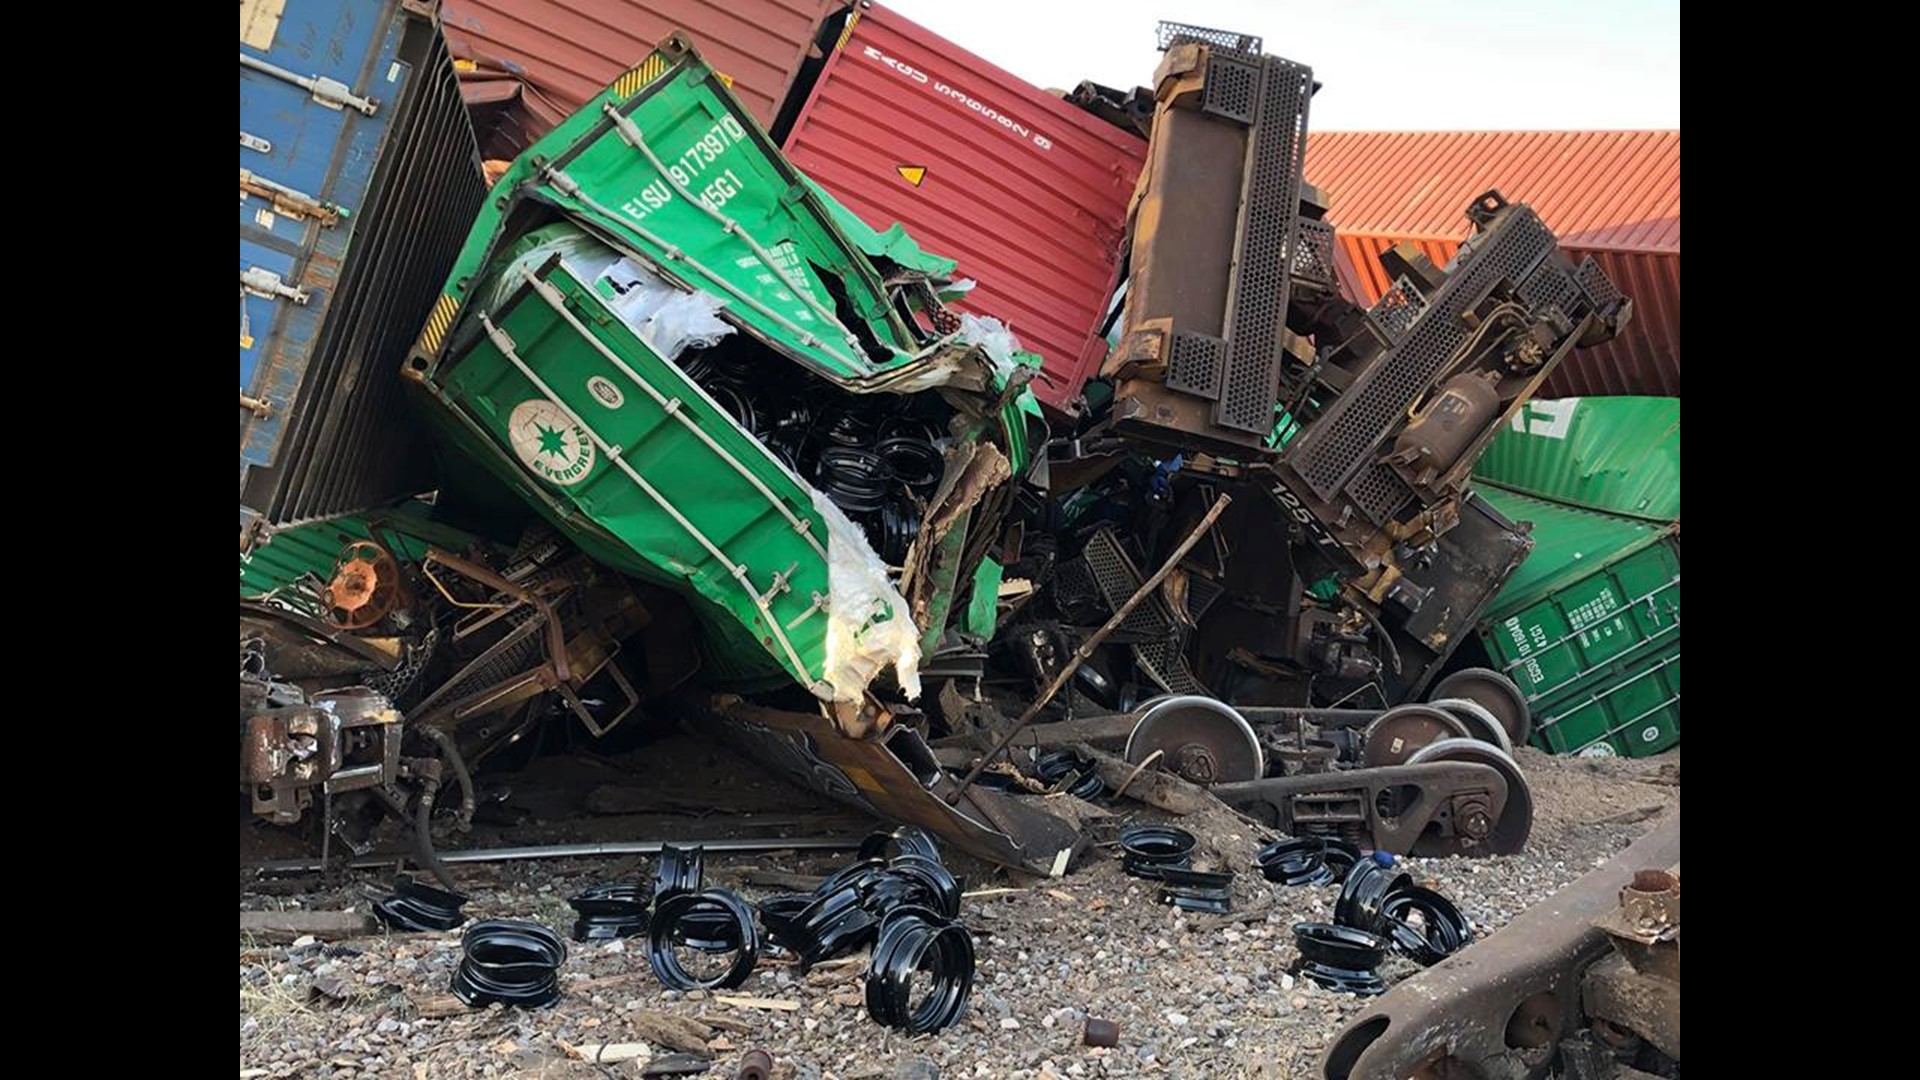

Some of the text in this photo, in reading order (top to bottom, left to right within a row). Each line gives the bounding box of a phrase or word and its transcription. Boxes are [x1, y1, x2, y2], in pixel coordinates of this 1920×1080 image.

[863, 45, 929, 84] MAGU
[933, 80, 1030, 138] 536582
[621, 178, 672, 219] EISU
[533, 425, 591, 480] EVERGREEN
[1271, 480, 1340, 548] 125-T
[1529, 624, 1547, 648] 42G1
[1524, 657, 1544, 684] EGSU
